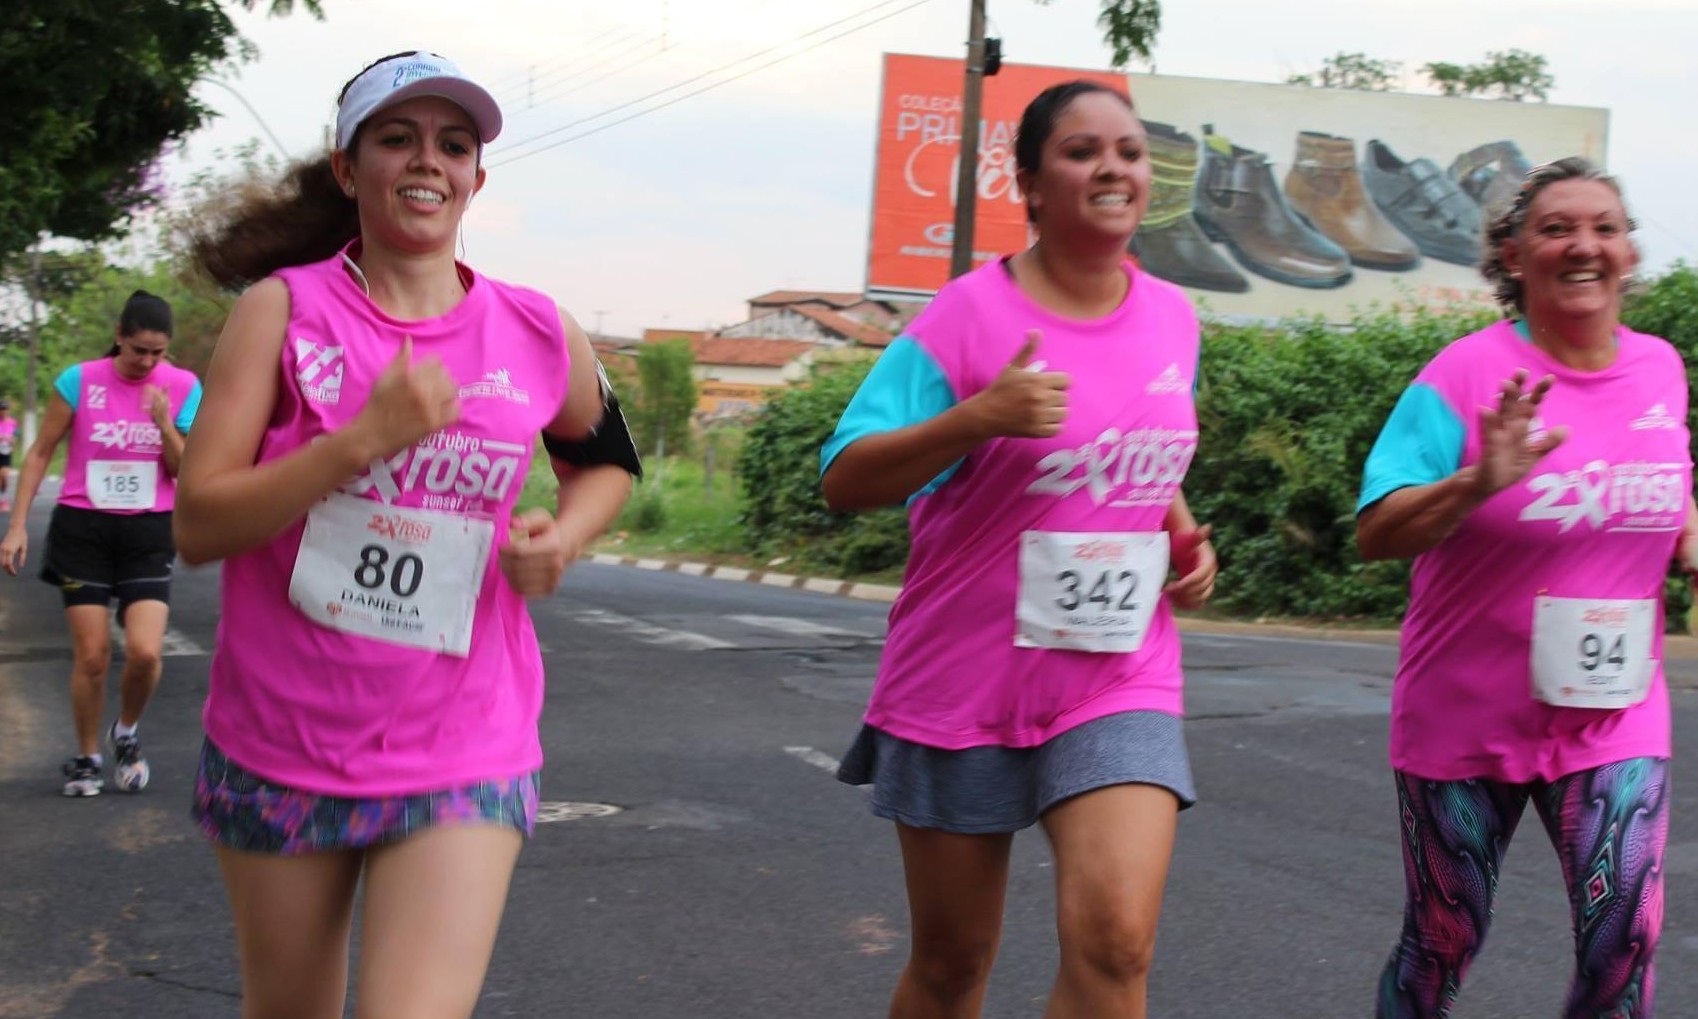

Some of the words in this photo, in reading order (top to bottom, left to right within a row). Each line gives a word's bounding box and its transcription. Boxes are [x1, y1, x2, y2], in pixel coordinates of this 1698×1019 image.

[899, 94, 964, 112] COLEÇÃ
[103, 475, 140, 493] 185
[404, 446, 519, 502] rosa
[354, 543, 424, 588] 80
[341, 588, 420, 618] DANIELA
[1055, 569, 1139, 611] 342
[1579, 633, 1627, 671] 94
